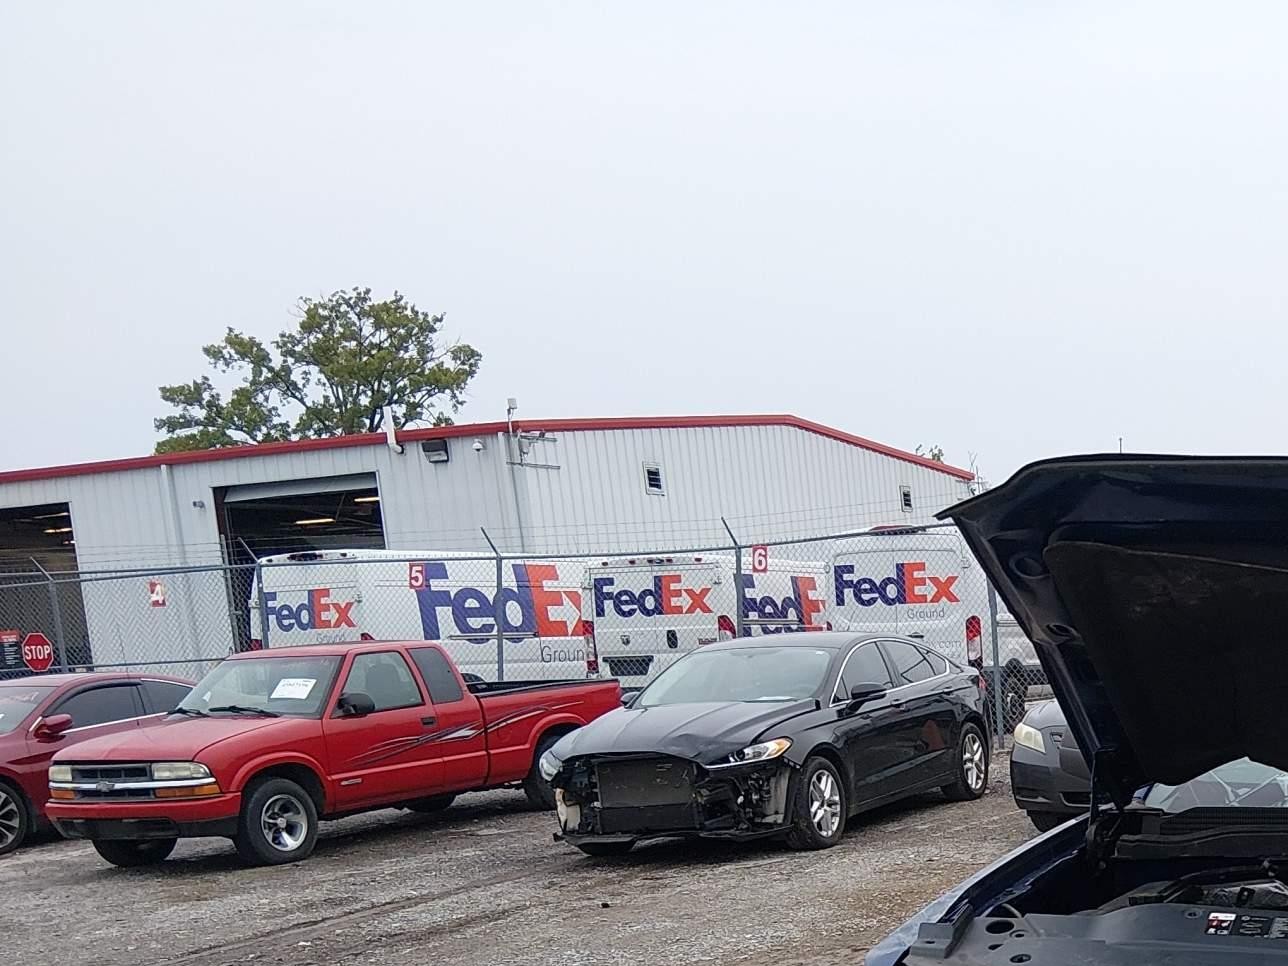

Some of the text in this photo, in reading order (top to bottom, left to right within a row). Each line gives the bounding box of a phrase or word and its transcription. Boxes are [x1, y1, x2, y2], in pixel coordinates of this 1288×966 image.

[754, 549, 766, 571] 6
[411, 566, 423, 587] 5
[834, 562, 960, 607] FedEx
[150, 584, 165, 604] 4
[594, 574, 714, 618] FedEx
[263, 588, 358, 632] FedEx
[734, 574, 827, 638] FedE
[906, 608, 945, 620] Ground
[25, 645, 51, 660] STOP
[542, 645, 585, 663] Groun
